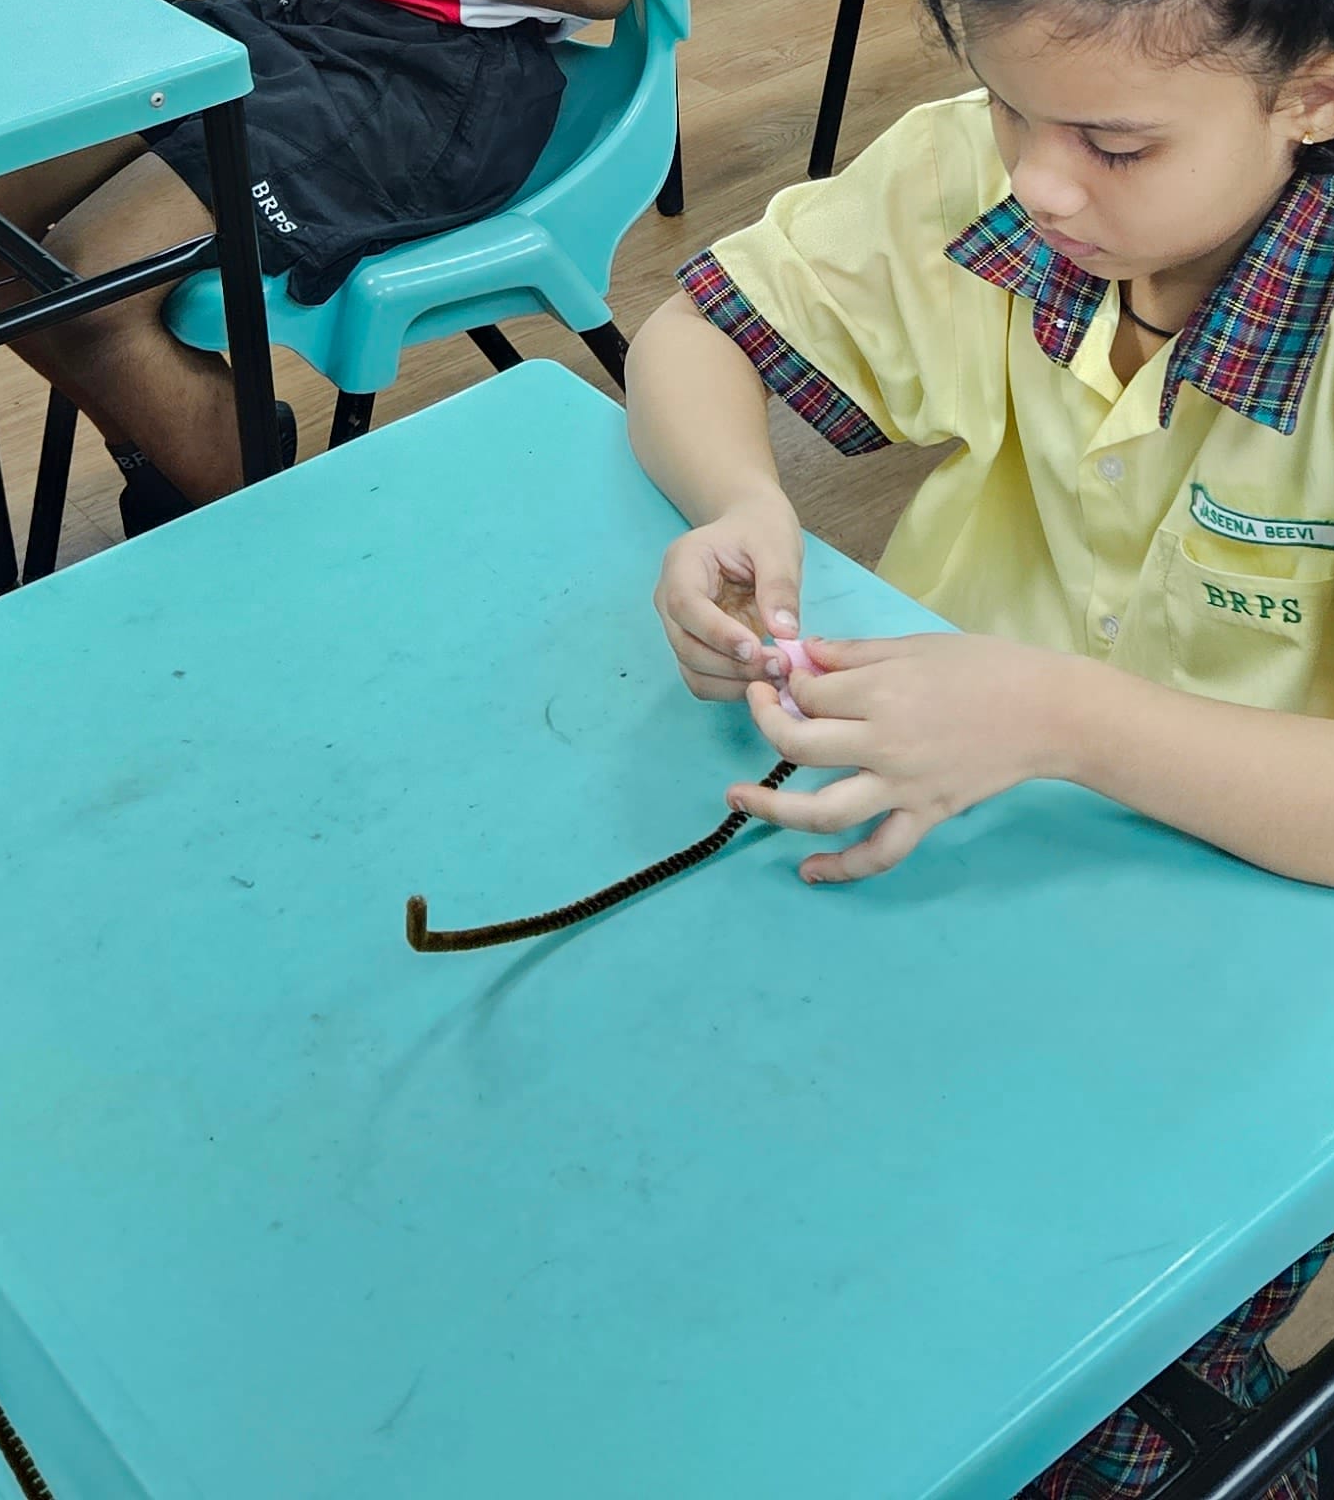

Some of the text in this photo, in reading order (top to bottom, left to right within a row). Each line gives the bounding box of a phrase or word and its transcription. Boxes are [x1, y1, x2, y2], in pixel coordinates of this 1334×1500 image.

[251, 180, 298, 233] BRPS
[1264, 525, 1315, 541] BEEVI
[1201, 581, 1303, 624] BRPS
